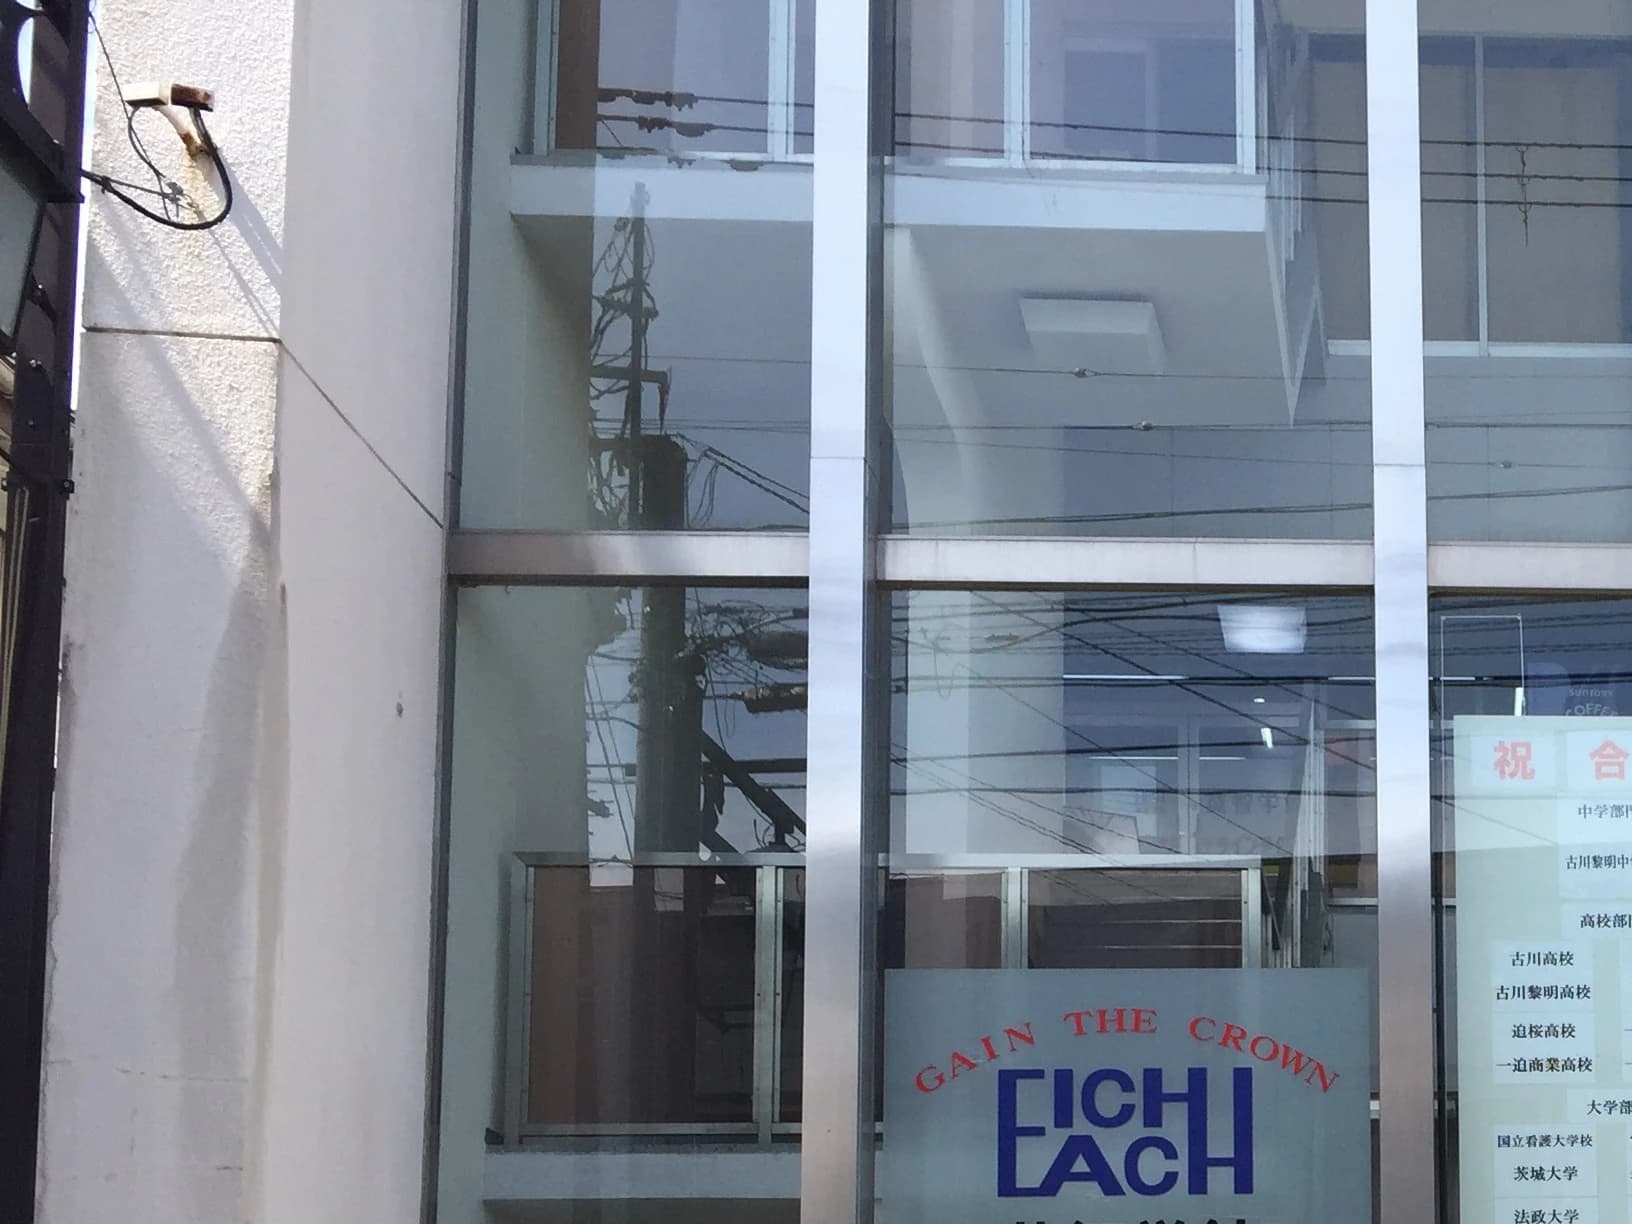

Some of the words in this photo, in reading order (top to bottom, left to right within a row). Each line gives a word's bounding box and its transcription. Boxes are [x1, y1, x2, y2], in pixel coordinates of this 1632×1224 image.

[1510, 951, 1574, 967] 古川高校
[1496, 985, 1591, 1000] 古川黎明高校
[1512, 1023, 1576, 1039] 迫桜高校
[914, 1021, 1037, 1095] GAIN
[1063, 1008, 1158, 1036] THE
[1188, 1016, 1340, 1094] CROWN
[1496, 1056, 1593, 1073] 一迫商業高校
[1497, 1134, 1593, 1149] 国立看護大学校
[1513, 1166, 1578, 1182] 茨城大学
[1513, 1209, 1579, 1224] 法政大学
